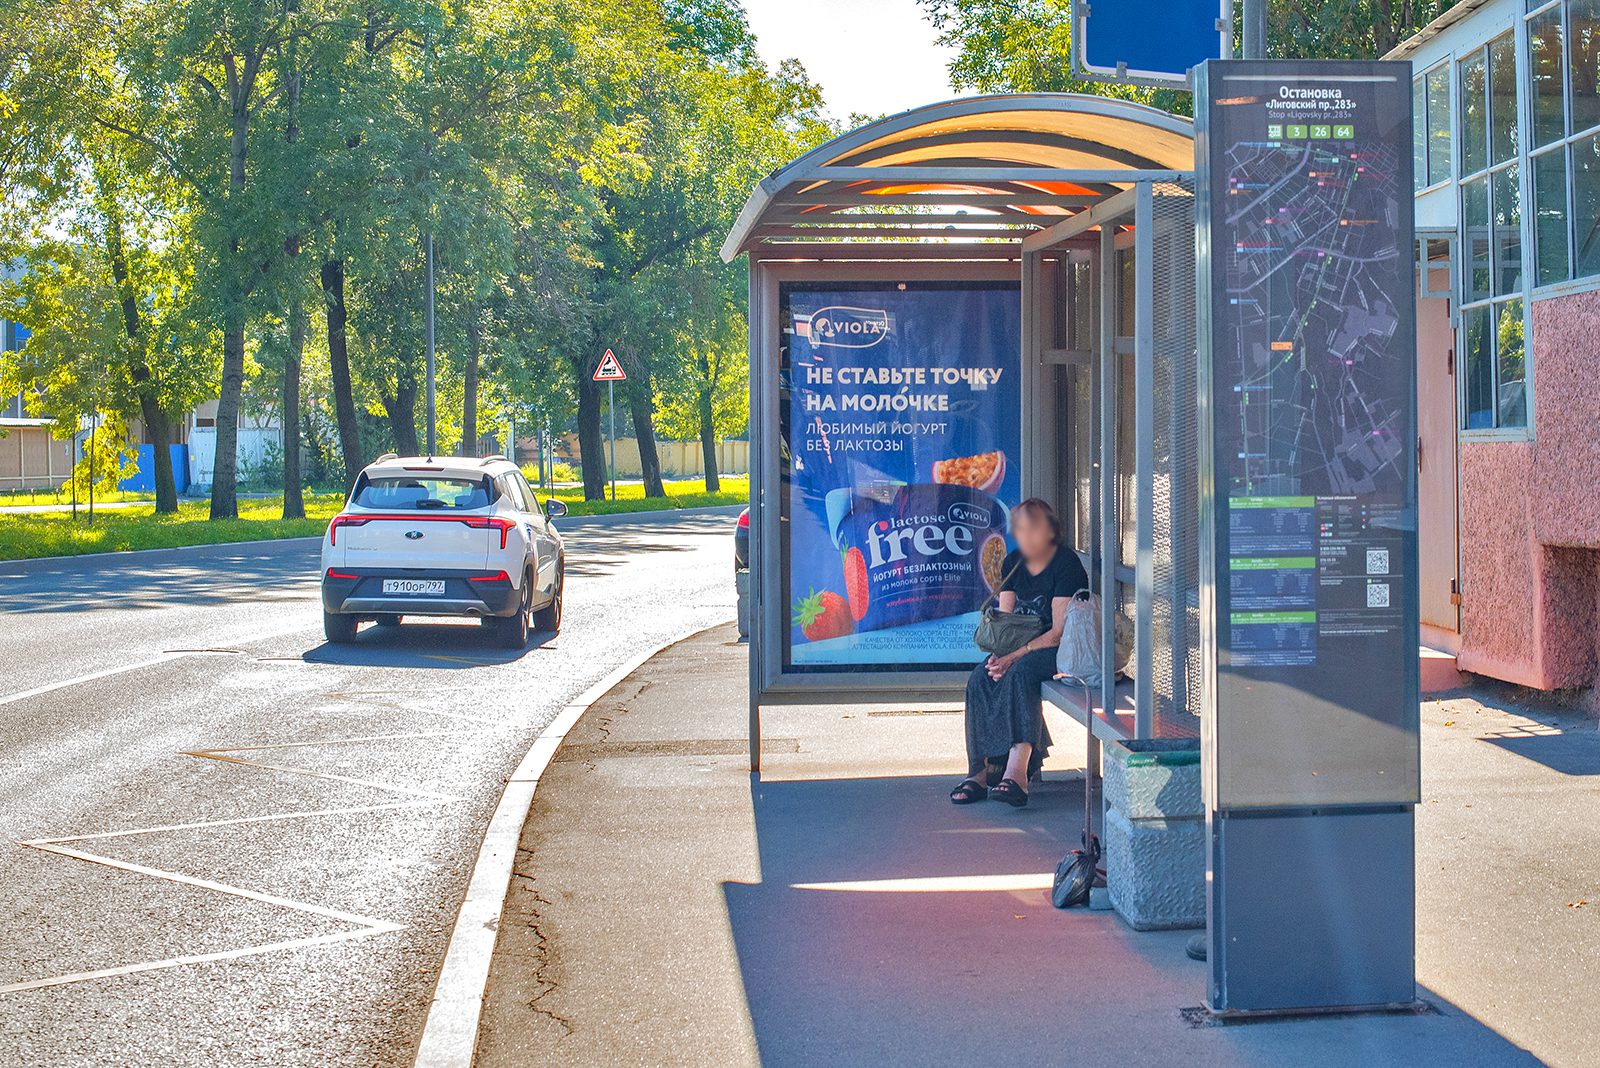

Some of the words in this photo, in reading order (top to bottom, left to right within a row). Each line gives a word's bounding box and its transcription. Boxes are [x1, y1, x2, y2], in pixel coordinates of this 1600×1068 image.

[1279, 85, 1342, 99] Остановка
[1265, 99, 1317, 109] «Лиговский
[1268, 110, 1286, 119] Stop
[1287, 110, 1321, 119] «Ligovsky
[1294, 127, 1300, 137] 3
[1314, 127, 1327, 137] 26
[1337, 127, 1350, 137] 64
[834, 321, 881, 334] VIOLA
[806, 367, 833, 385] НЕ
[837, 367, 926, 385] СТАВЬТЕ
[930, 367, 1003, 385] ТОЧКУ
[806, 394, 837, 411] НА
[805, 421, 887, 435] ЛЮБИМЫЙ
[890, 421, 948, 435] ЙОГУРТ
[806, 439, 831, 451] БЕЗ
[834, 439, 903, 451] ЛАКТОЗЫ
[891, 514, 946, 529] lactose
[963, 510, 988, 523] VIOLA
[865, 520, 973, 569] free
[873, 566, 902, 583] ЙОГУРТ
[903, 561, 972, 575] БЕЗЛАКТОЗНЫЙ
[427, 581, 443, 590] 797
[890, 577, 918, 589] молока
[919, 574, 943, 585] сорта
